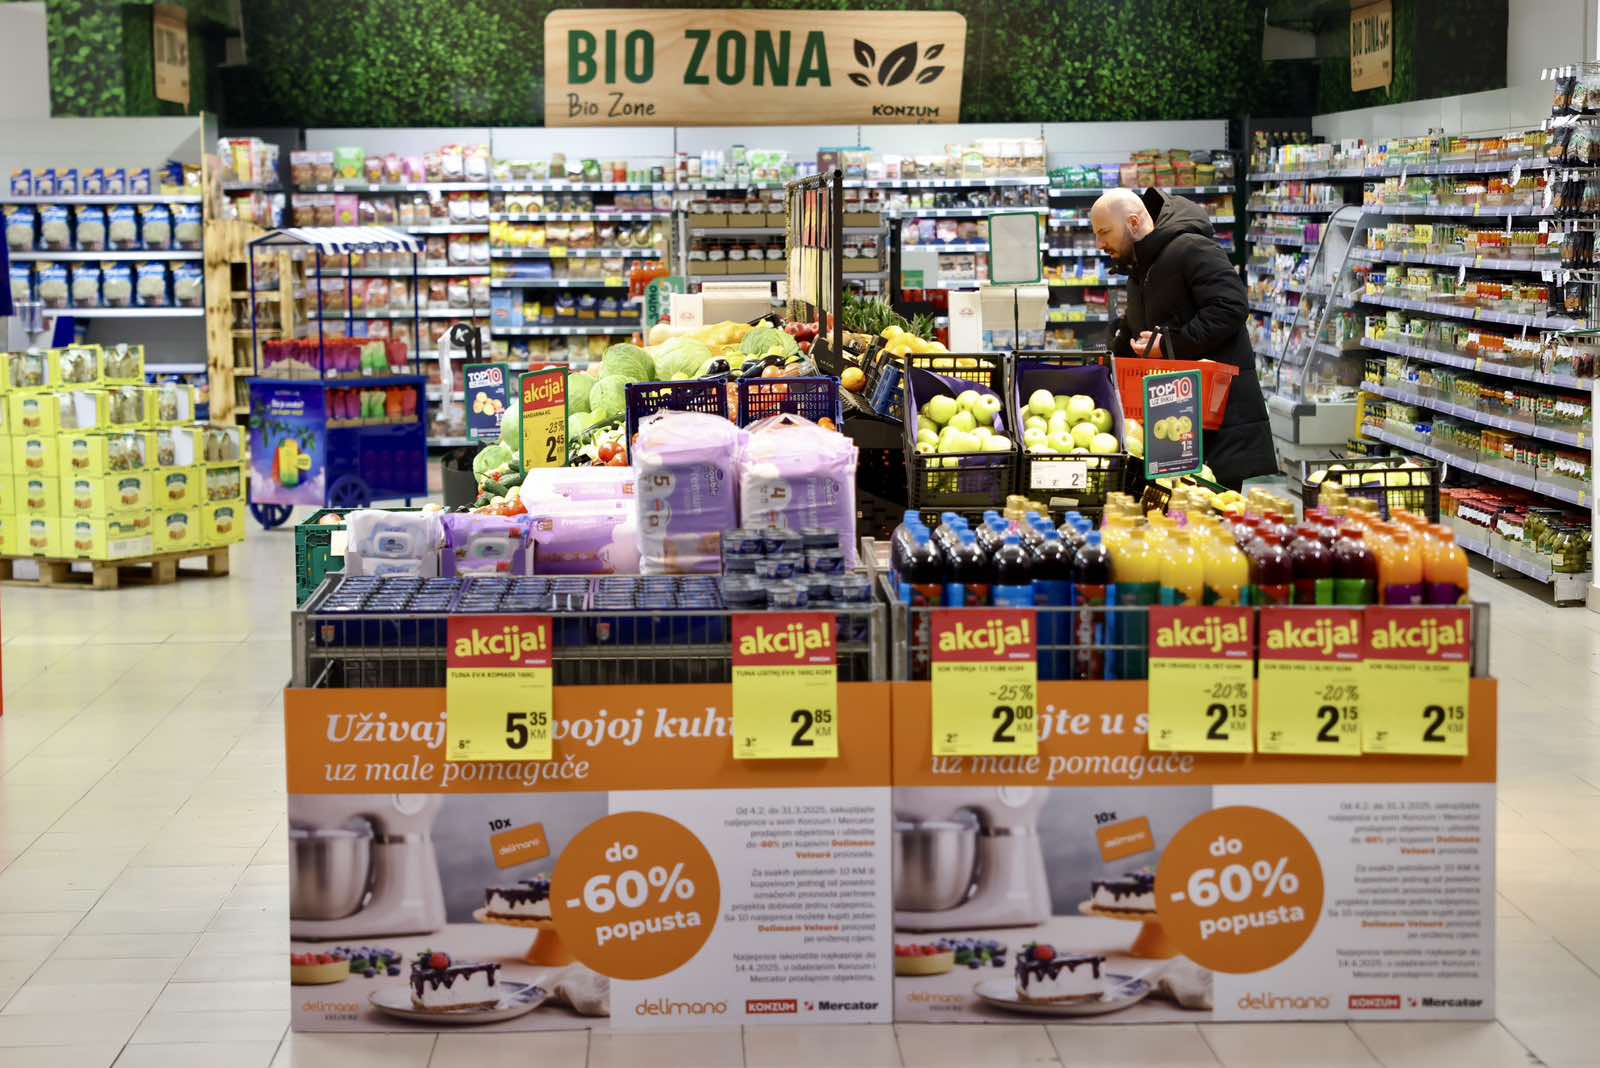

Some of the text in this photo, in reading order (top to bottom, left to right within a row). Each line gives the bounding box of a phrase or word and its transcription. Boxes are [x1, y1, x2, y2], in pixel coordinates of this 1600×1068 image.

[567, 29, 832, 87] BIO ZONA
[567, 92, 656, 118] Bio Zone
[872, 104, 939, 117] KONZUM
[523, 375, 565, 404] akcija!
[1148, 376, 1193, 399] TOP10
[546, 436, 557, 463] 2
[1071, 473, 1080, 486] 2
[455, 625, 547, 661] akcija!
[739, 622, 831, 659] akcija!
[939, 618, 1031, 655] akcija!
[1156, 616, 1248, 653] akcija!
[1266, 618, 1359, 655] akcija!
[1371, 618, 1465, 655] akcija!
[989, 684, 1034, 701] -25%
[1203, 682, 1248, 699] -20%
[1314, 685, 1360, 701] -20%
[327, 711, 447, 749] Uživaj
[552, 706, 645, 747] vojoj
[506, 711, 547, 750] 5 35
[530, 728, 547, 739] KM
[790, 709, 832, 747] 2 85
[815, 726, 832, 737] KM
[992, 705, 1033, 742] 2 00
[1100, 713, 1124, 735] u
[1206, 703, 1248, 741] 2 15
[1316, 705, 1359, 743] 2 15
[1422, 704, 1465, 743] 2 15
[324, 754, 590, 787] uz male pomagače
[931, 752, 1196, 781] uz male pomagače
[488, 817, 512, 832] 10x
[1094, 811, 1118, 825] 10x
[499, 837, 542, 856] delimano
[605, 842, 639, 863] do
[1208, 836, 1243, 857] do
[566, 863, 696, 914] -60%
[1169, 857, 1300, 908] -60%
[595, 911, 702, 946] popusta
[1199, 905, 1305, 939] popusta
[634, 998, 729, 1017] delimano
[747, 1001, 797, 1011] KONZUM
[818, 1001, 879, 1011] Mercator
[1237, 992, 1331, 1010] delimano
[1421, 997, 1484, 1008] Mercator
